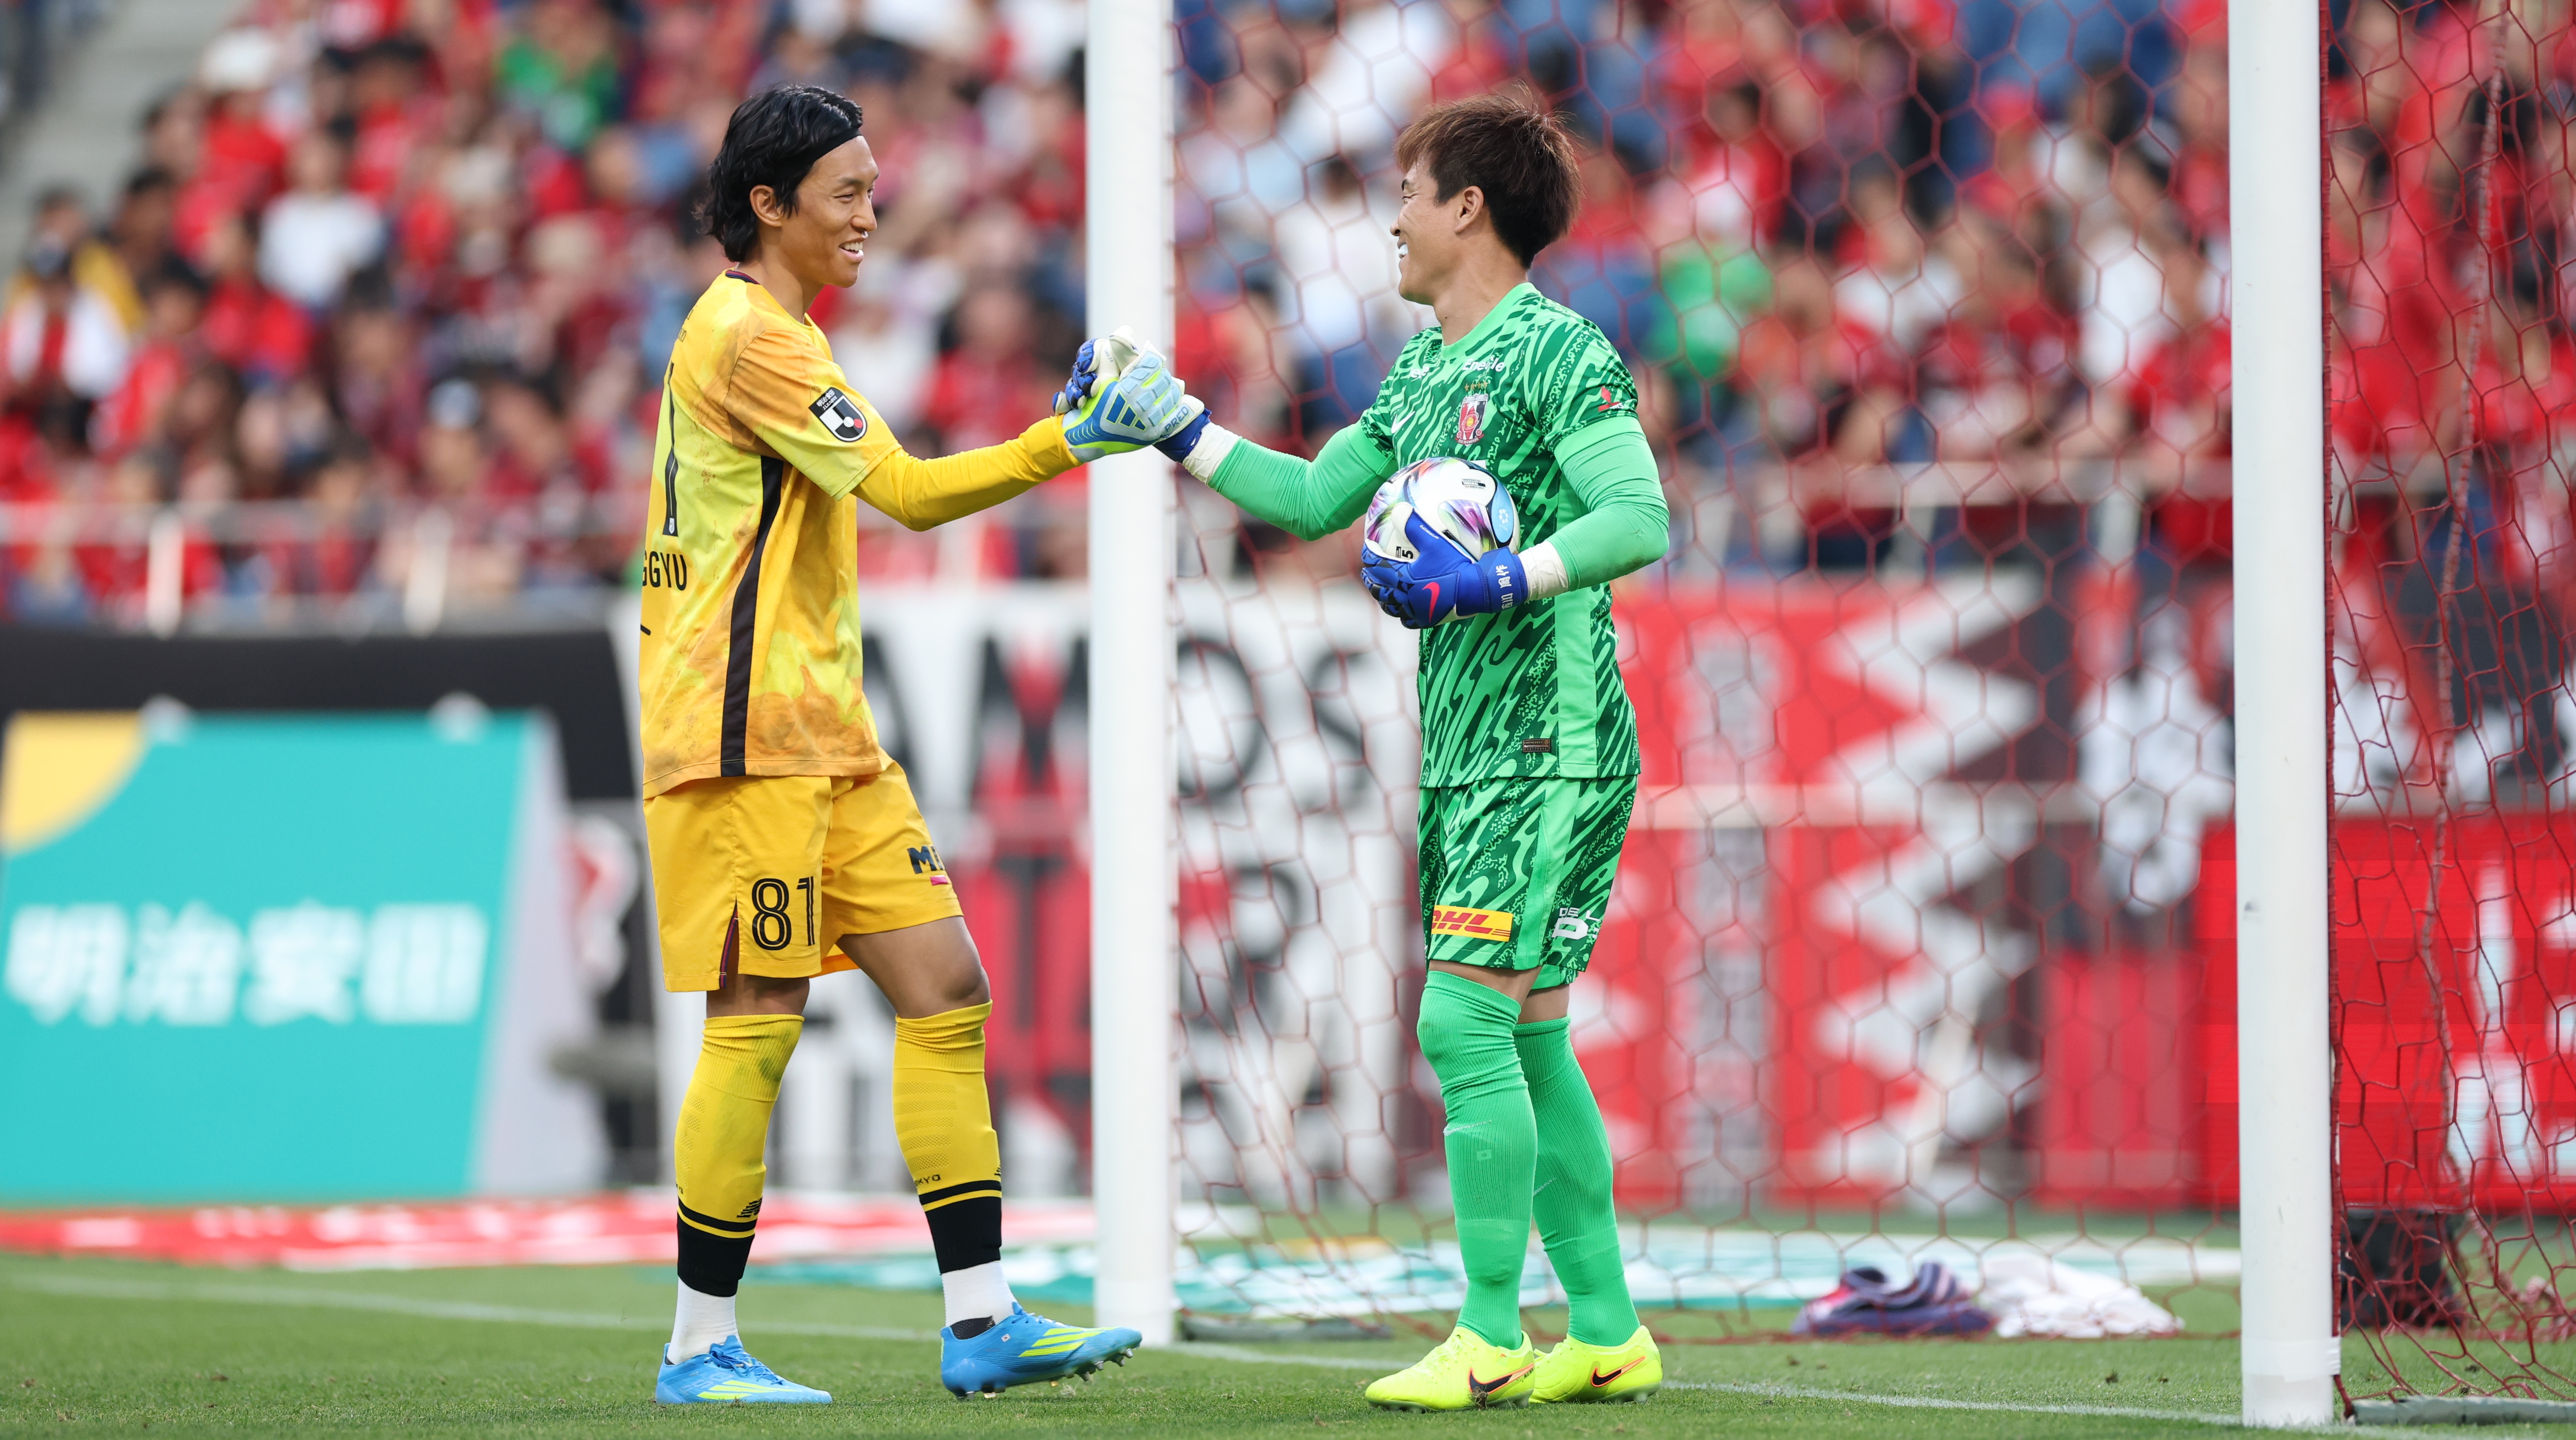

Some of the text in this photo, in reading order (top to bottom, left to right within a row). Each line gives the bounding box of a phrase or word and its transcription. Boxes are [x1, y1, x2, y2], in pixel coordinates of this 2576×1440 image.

[816, 389, 835, 407] 明治安田
[1164, 406, 1189, 432] PRED
[1402, 549, 1414, 559] 5
[751, 876, 815, 951] 81
